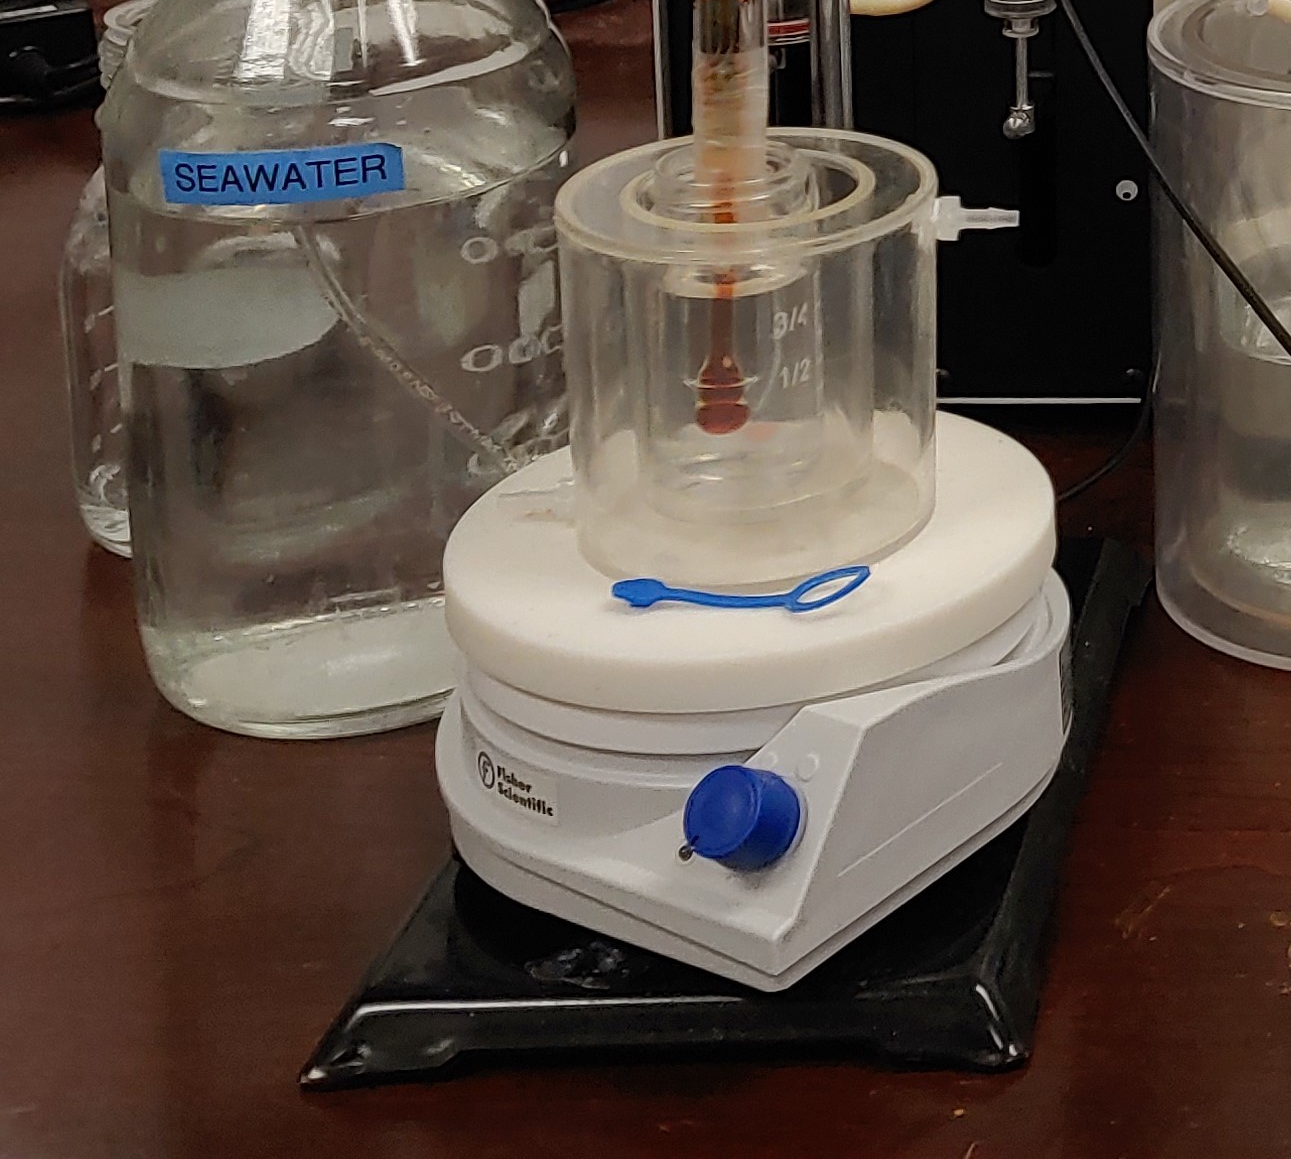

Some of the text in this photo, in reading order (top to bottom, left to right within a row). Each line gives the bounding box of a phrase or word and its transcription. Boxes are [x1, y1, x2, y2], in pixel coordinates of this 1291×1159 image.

[174, 154, 388, 194] SEAWATER
[772, 308, 809, 342] 3/4
[779, 358, 810, 390] 1/2
[497, 765, 532, 794] Fisher
[498, 782, 554, 816] Scientific
